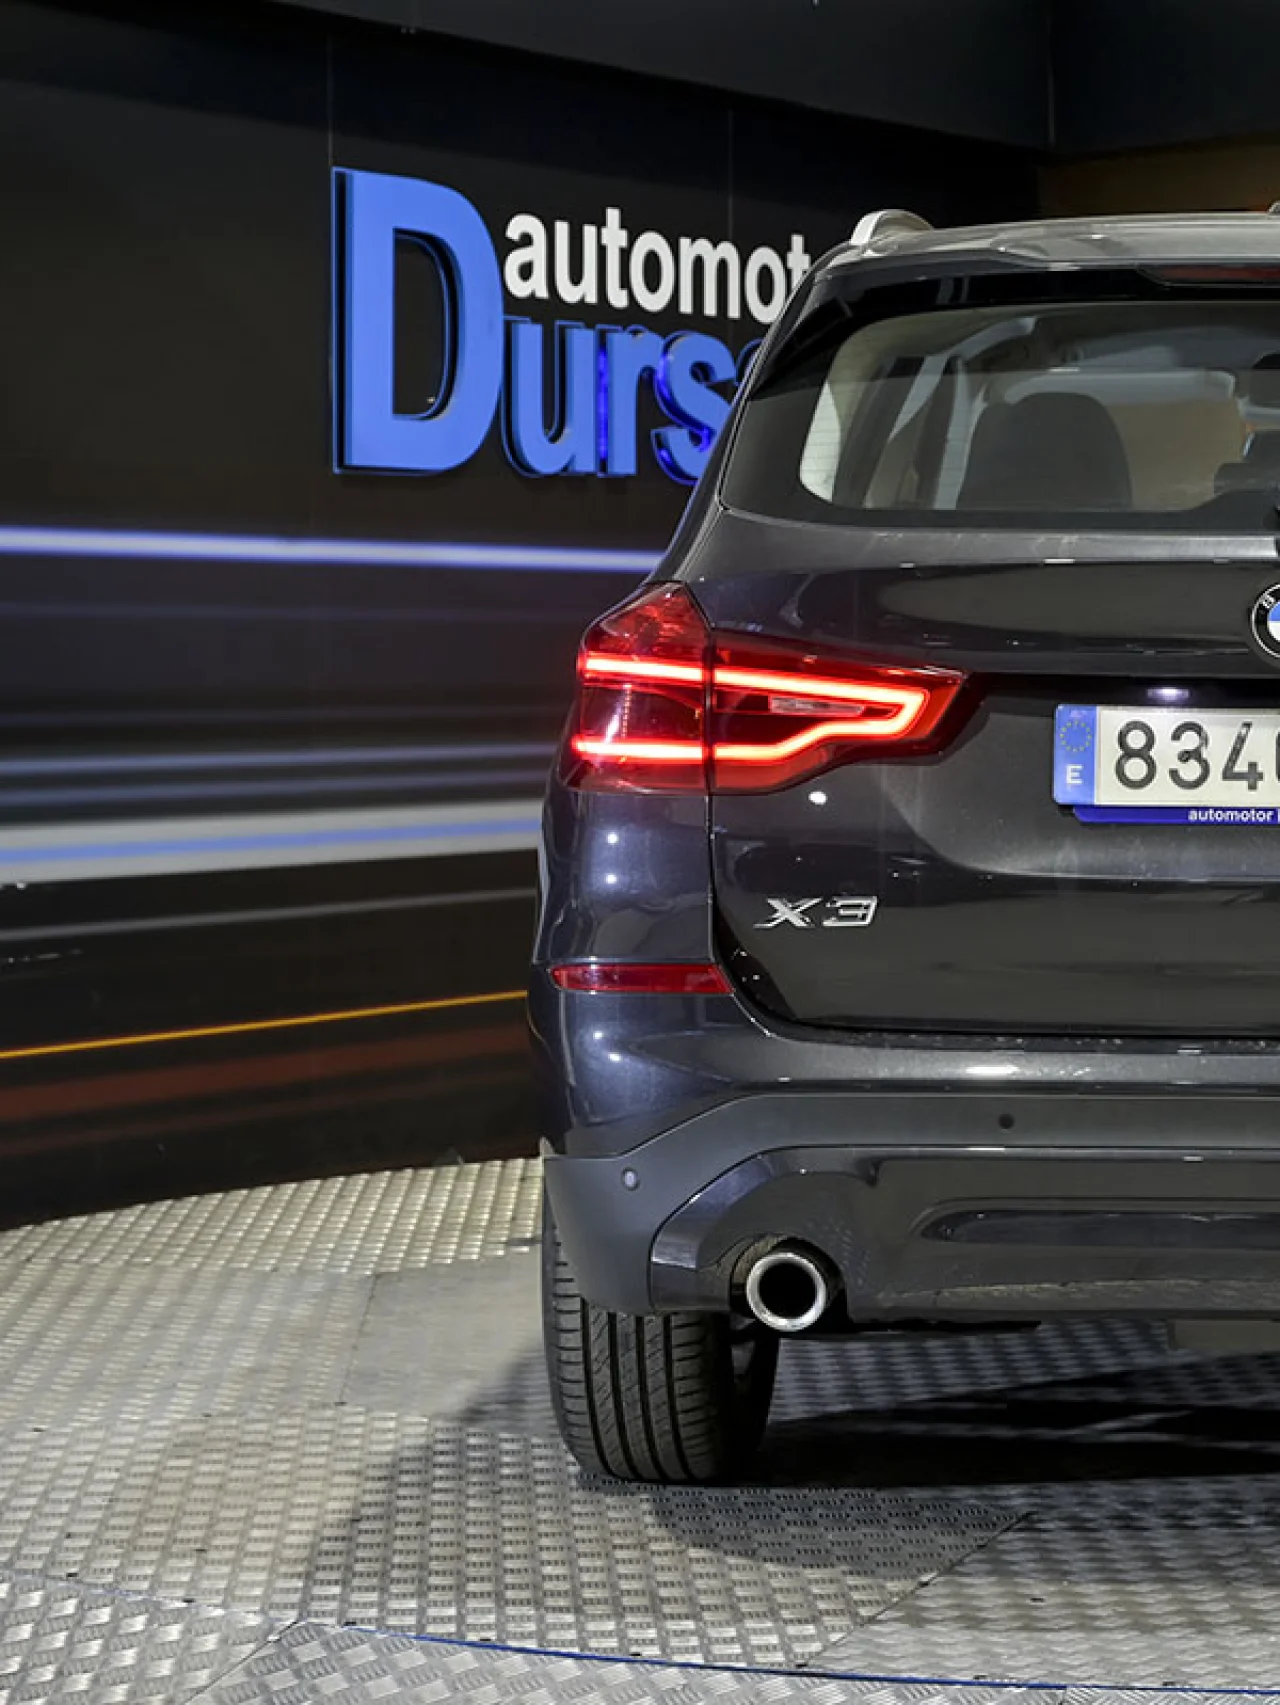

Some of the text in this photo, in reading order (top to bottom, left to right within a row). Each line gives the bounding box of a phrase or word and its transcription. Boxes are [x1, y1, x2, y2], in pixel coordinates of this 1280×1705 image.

[332, 166, 764, 486] Durs
[1066, 765, 1084, 785] E
[1188, 809, 1274, 823] automotor
[753, 895, 878, 928] X3
